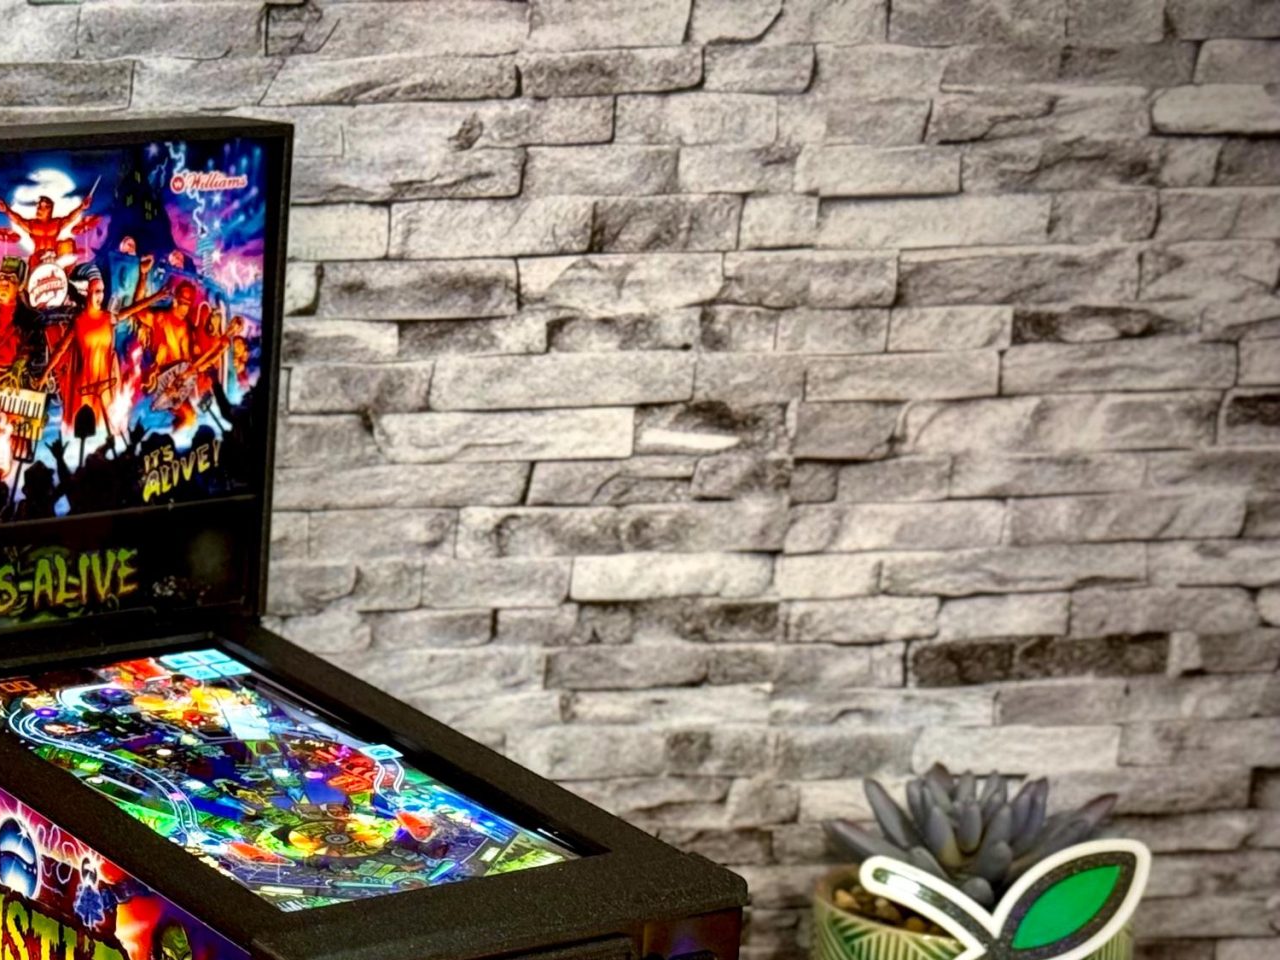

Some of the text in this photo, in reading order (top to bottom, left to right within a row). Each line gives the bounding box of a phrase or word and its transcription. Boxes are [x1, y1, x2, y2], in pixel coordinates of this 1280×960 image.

[184, 171, 247, 190] Williams
[143, 445, 175, 474] IT'S
[32, 549, 138, 606] ALIVE
